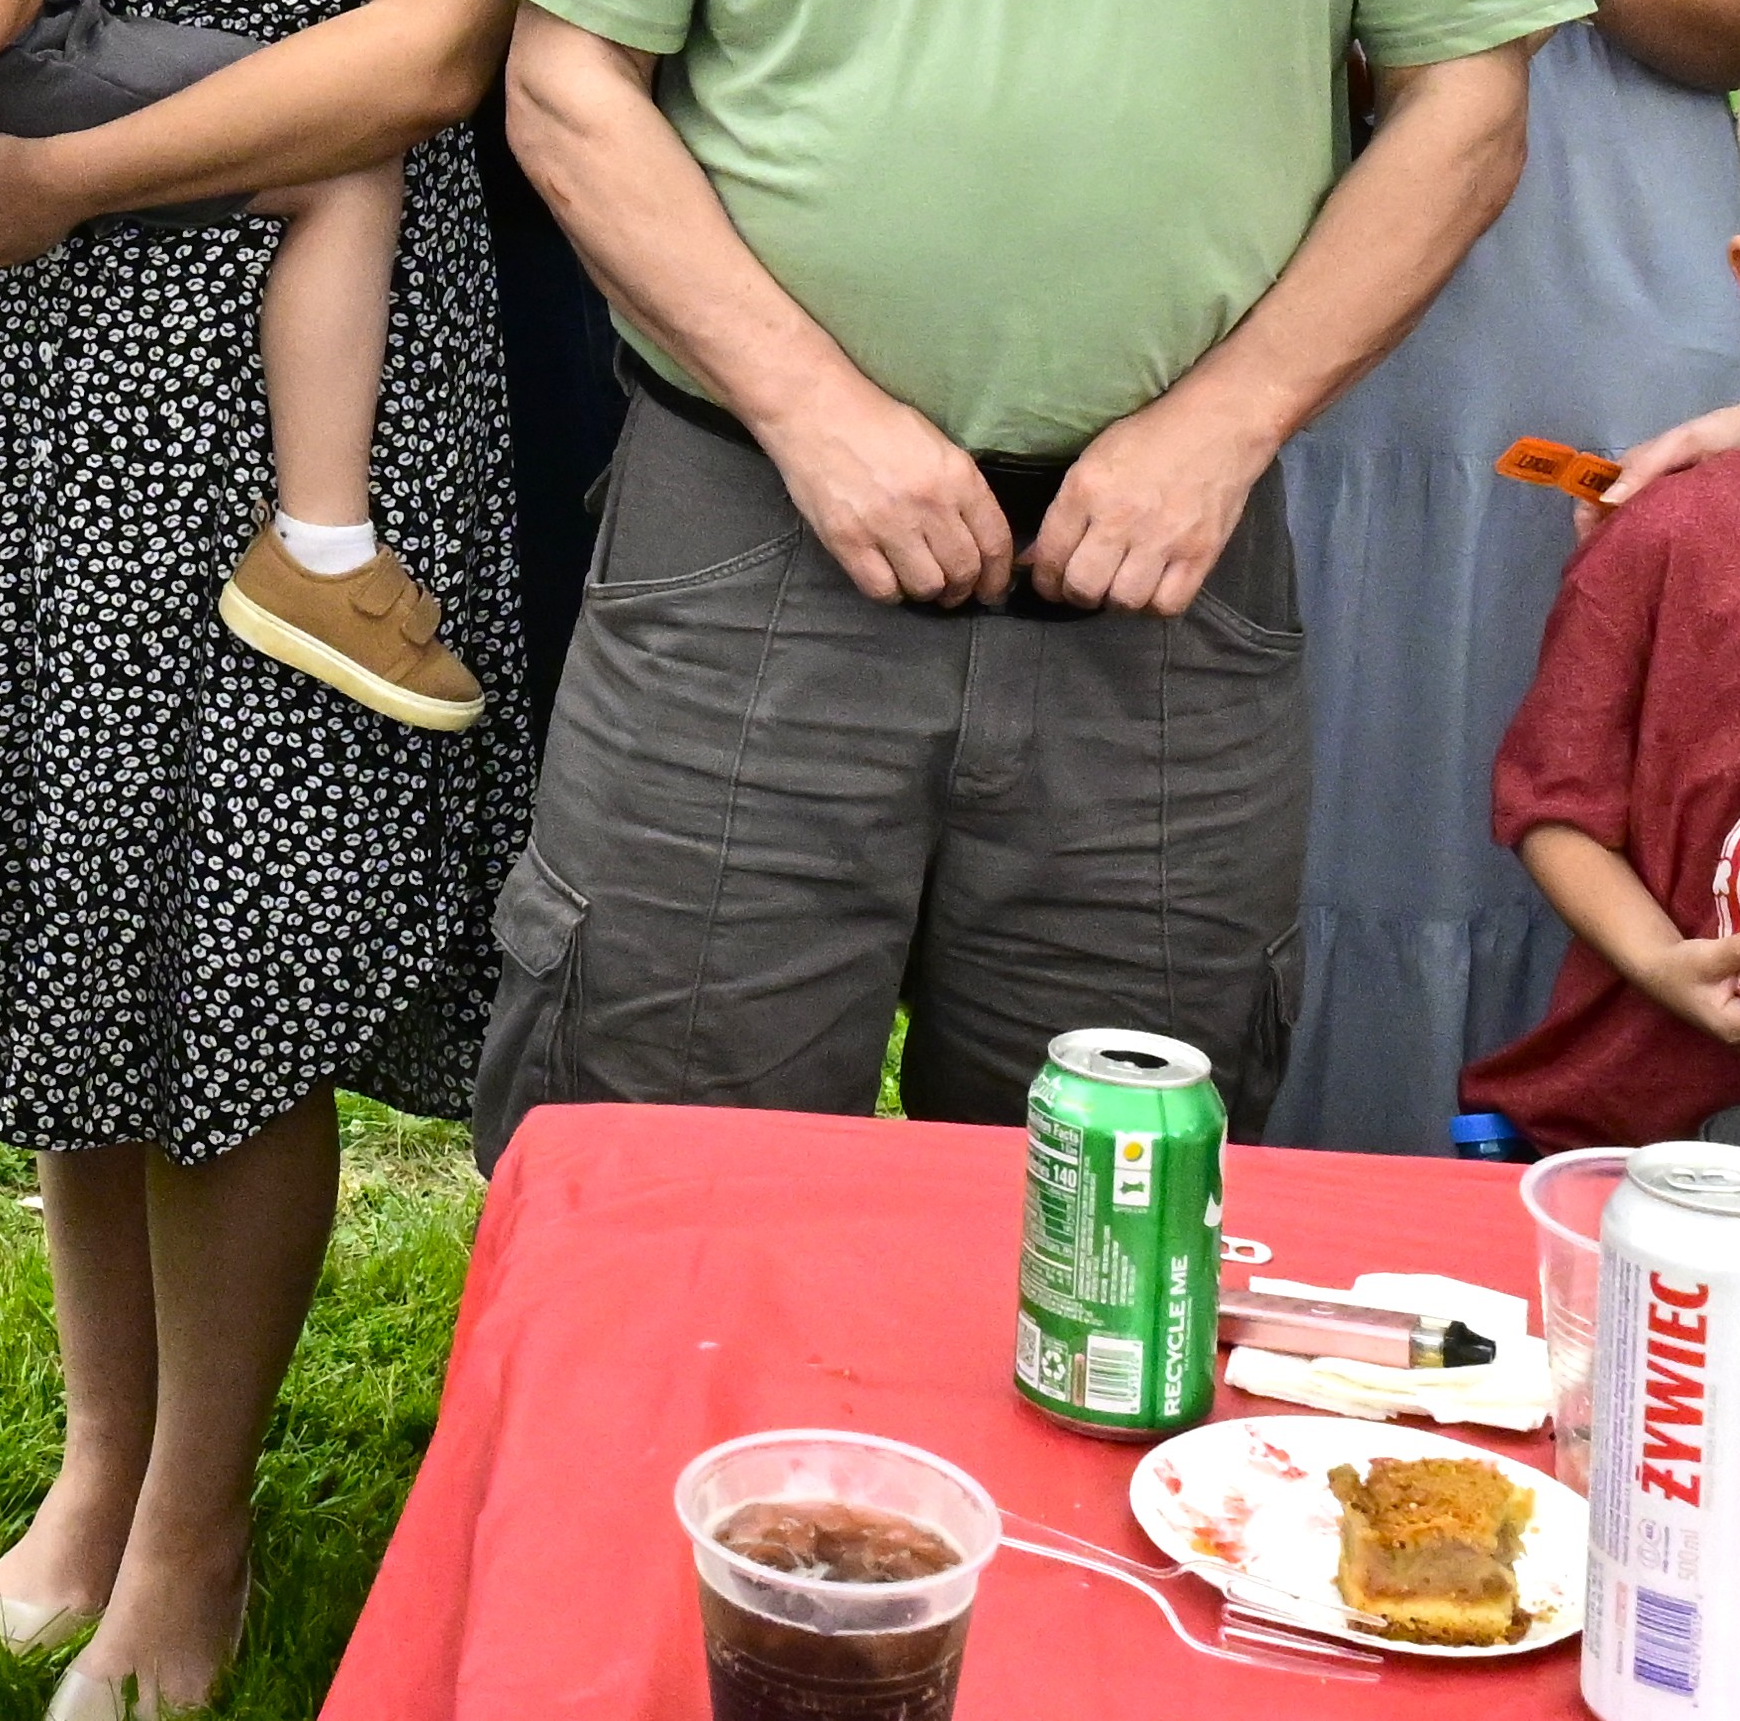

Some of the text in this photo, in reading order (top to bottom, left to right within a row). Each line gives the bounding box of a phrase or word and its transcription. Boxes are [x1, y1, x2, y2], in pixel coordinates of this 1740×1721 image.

[1054, 1164, 1078, 1188] 140
[1170, 1254, 1189, 1296] ME
[1164, 1299, 1186, 1417] RECYCLE
[1636, 1270, 1709, 1509] ŻYWIEC
